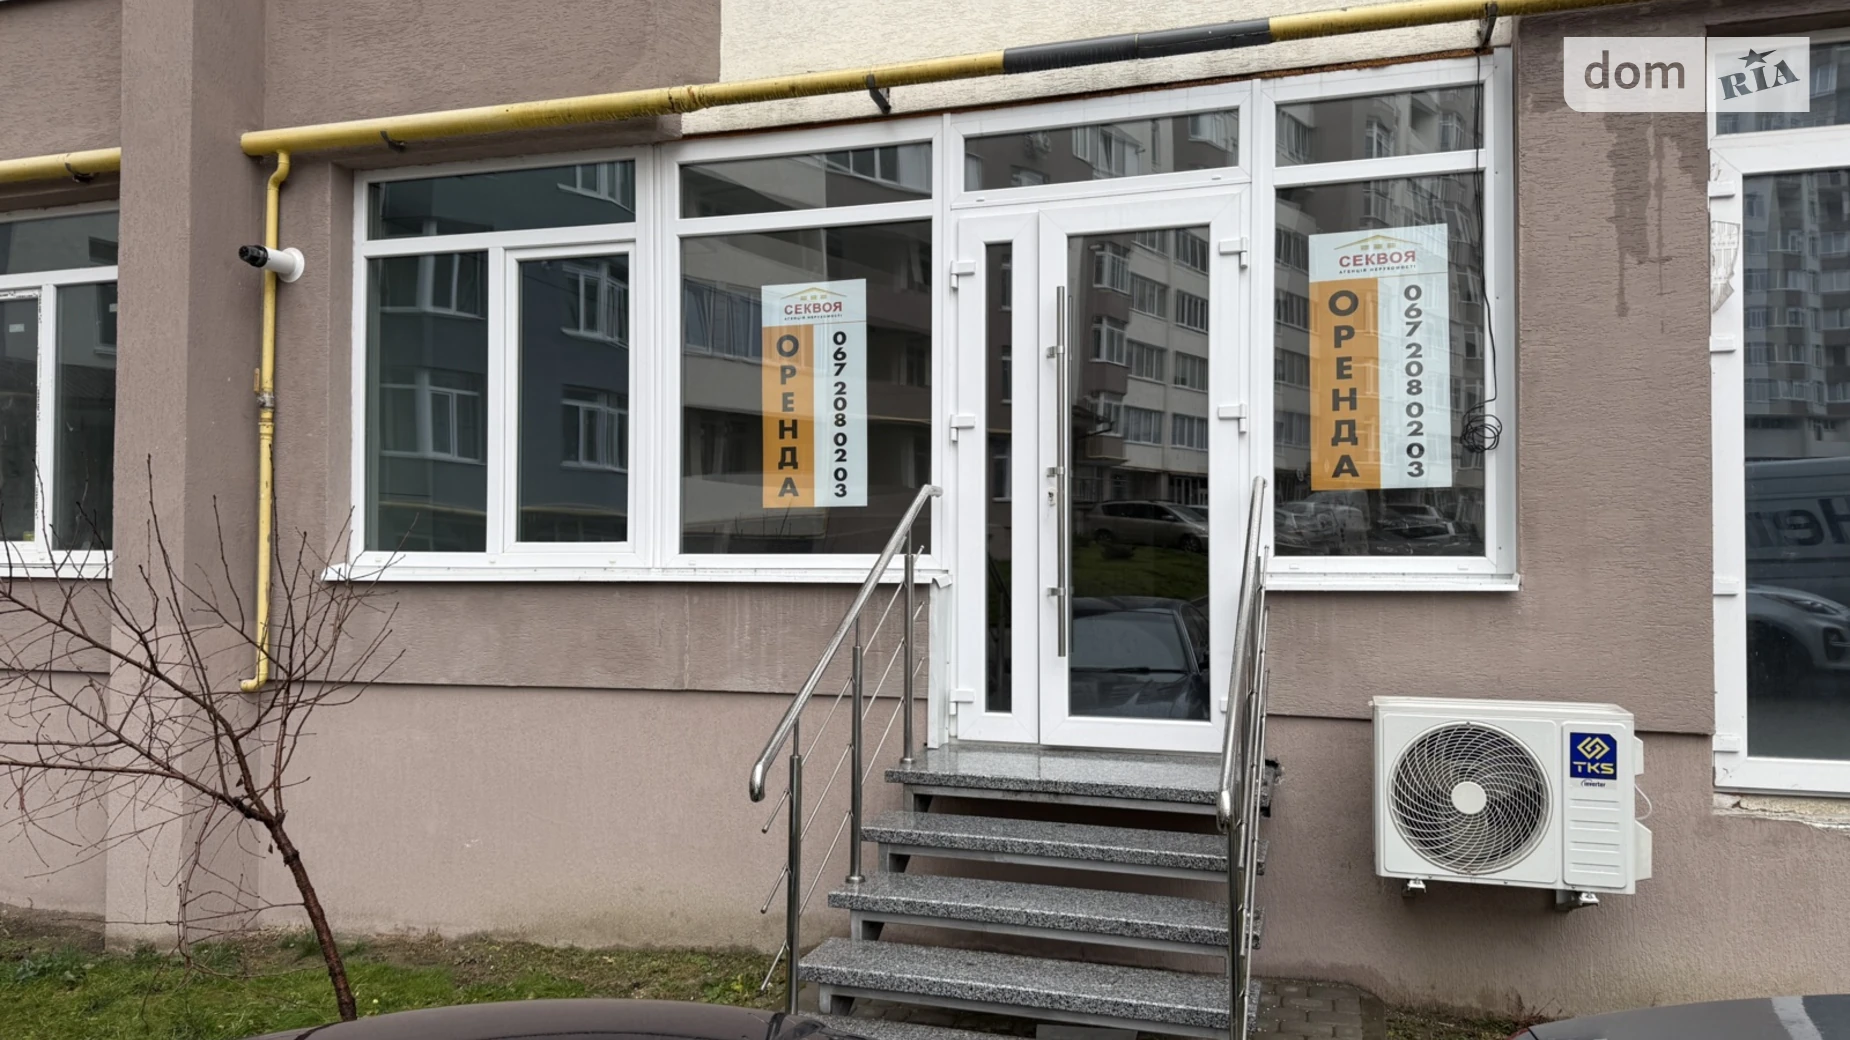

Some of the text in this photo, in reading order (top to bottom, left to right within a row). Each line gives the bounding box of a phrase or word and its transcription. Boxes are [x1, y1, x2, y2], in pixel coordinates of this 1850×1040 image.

[1339, 250, 1416, 268] СЕКВОЯ
[784, 301, 843, 315] СЕКВОЯ
[1328, 290, 1359, 478] ОРЕНДА
[776, 334, 799, 497] ОРЕНДА
[1573, 761, 1614, 774] TKS
